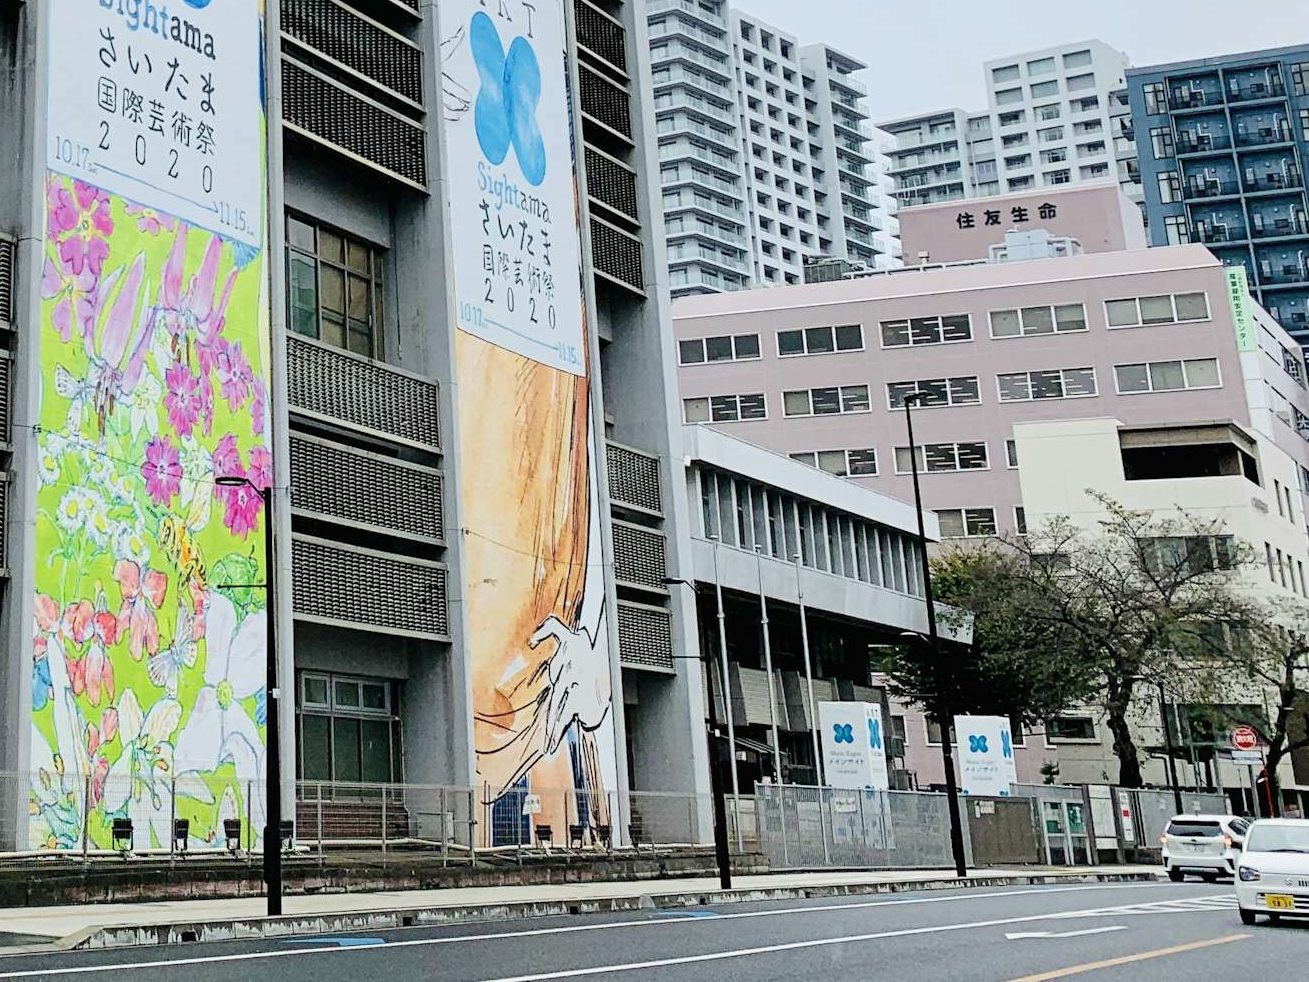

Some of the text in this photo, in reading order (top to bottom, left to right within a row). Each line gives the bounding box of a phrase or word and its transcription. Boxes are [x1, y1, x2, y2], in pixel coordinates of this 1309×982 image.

[99, 26, 216, 116] さいたま
[98, 76, 216, 156] 国際芸術祭
[98, 120, 213, 193] 2020
[476, 161, 552, 224] Sightama
[956, 202, 1057, 230] 住友生命
[478, 198, 552, 267] さいたま
[484, 277, 556, 331] 2020
